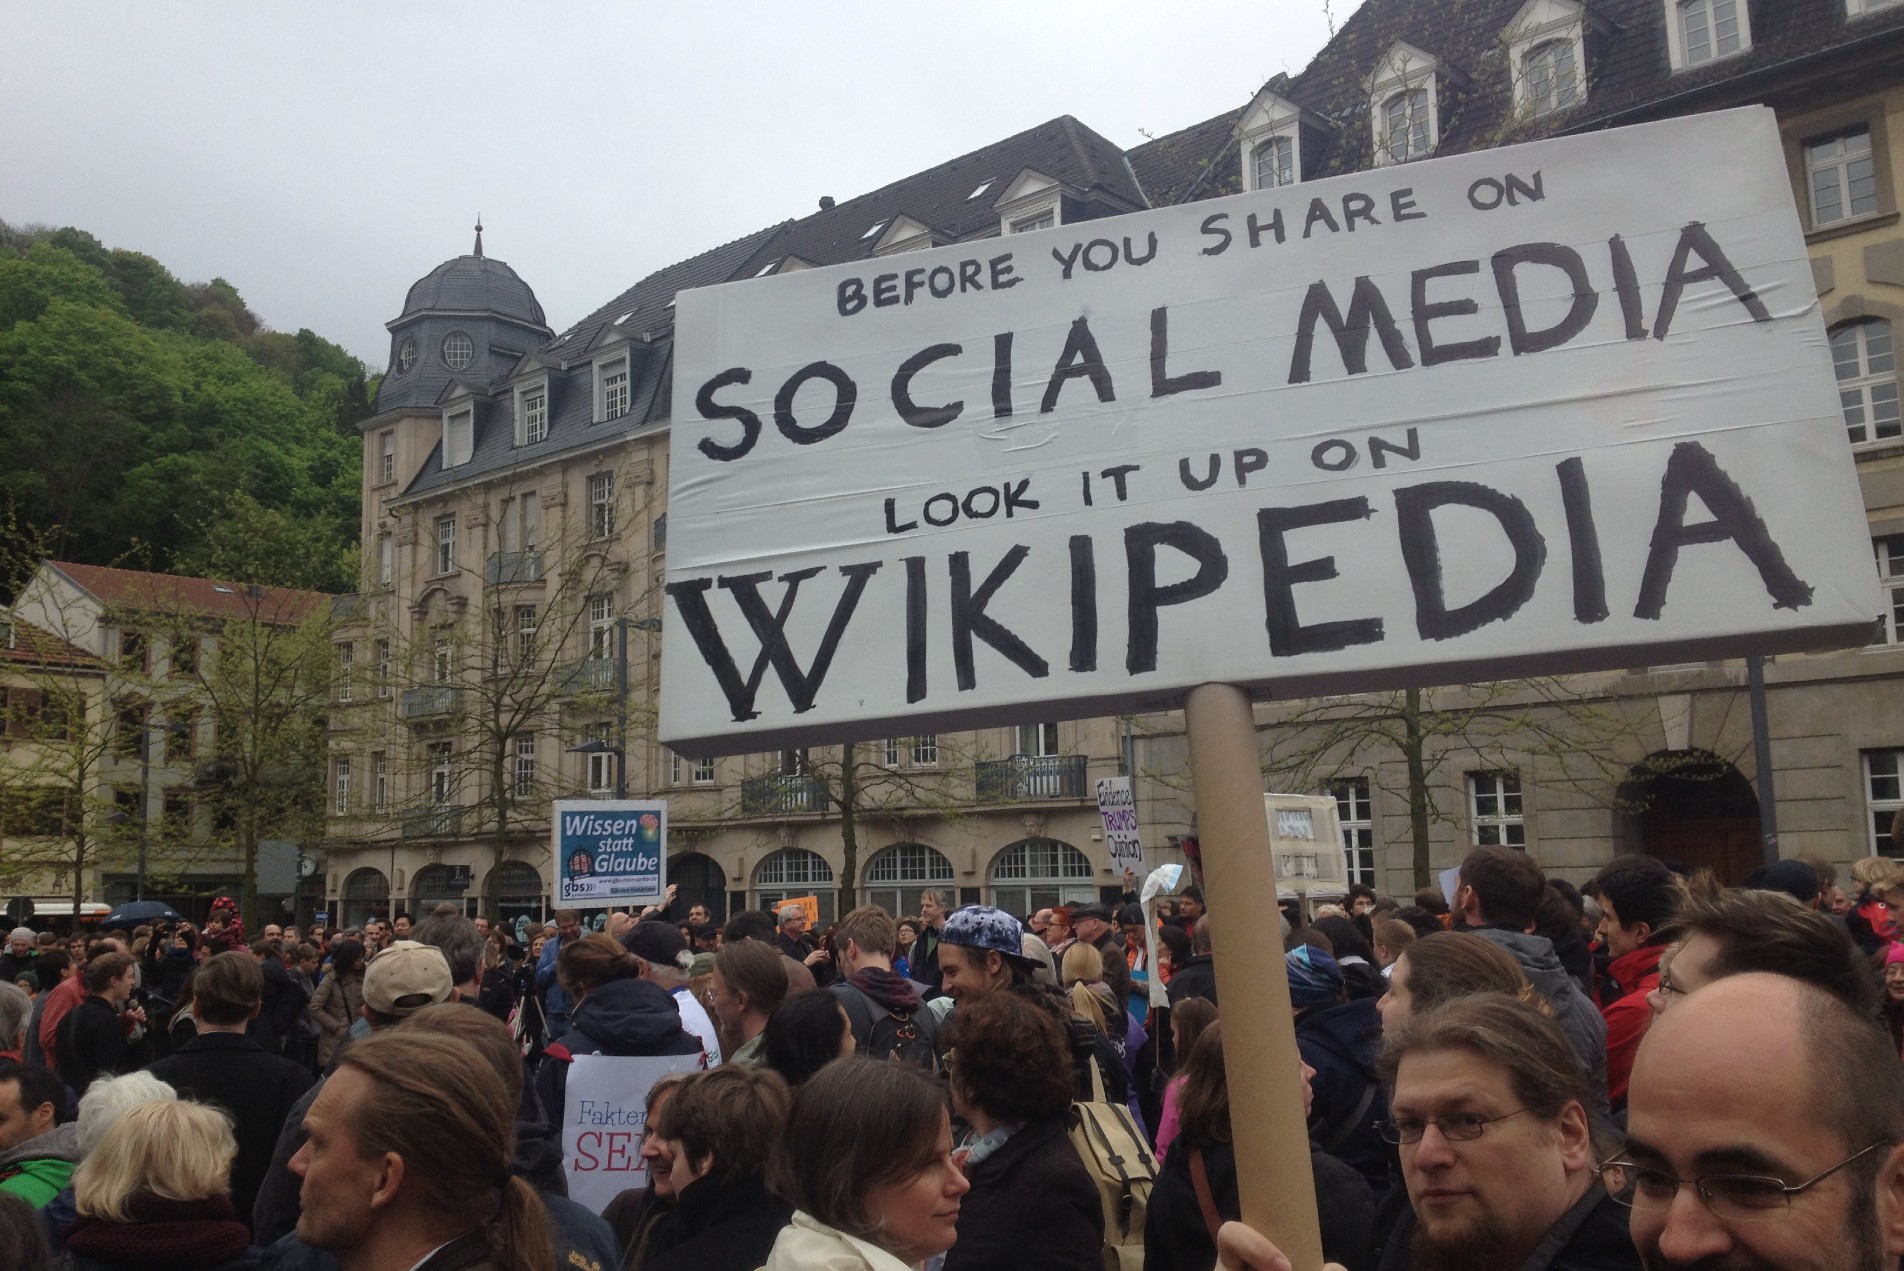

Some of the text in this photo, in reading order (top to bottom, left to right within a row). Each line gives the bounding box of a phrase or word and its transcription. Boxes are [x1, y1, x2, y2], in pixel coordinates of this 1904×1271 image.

[836, 170, 1546, 317] BEFORE YOU SHARE ON
[695, 220, 1777, 464] SOCIAL MEDIA
[884, 427, 1421, 535] LOOK IT UP ON
[665, 440, 1817, 723] WIKIPEDIA
[1097, 780, 1132, 806] Evidence
[565, 815, 637, 835] Wissen
[1101, 810, 1137, 831] TRUMPS
[598, 837, 634, 852] statt
[1107, 834, 1142, 868] Opinion
[594, 852, 658, 872] Glaube
